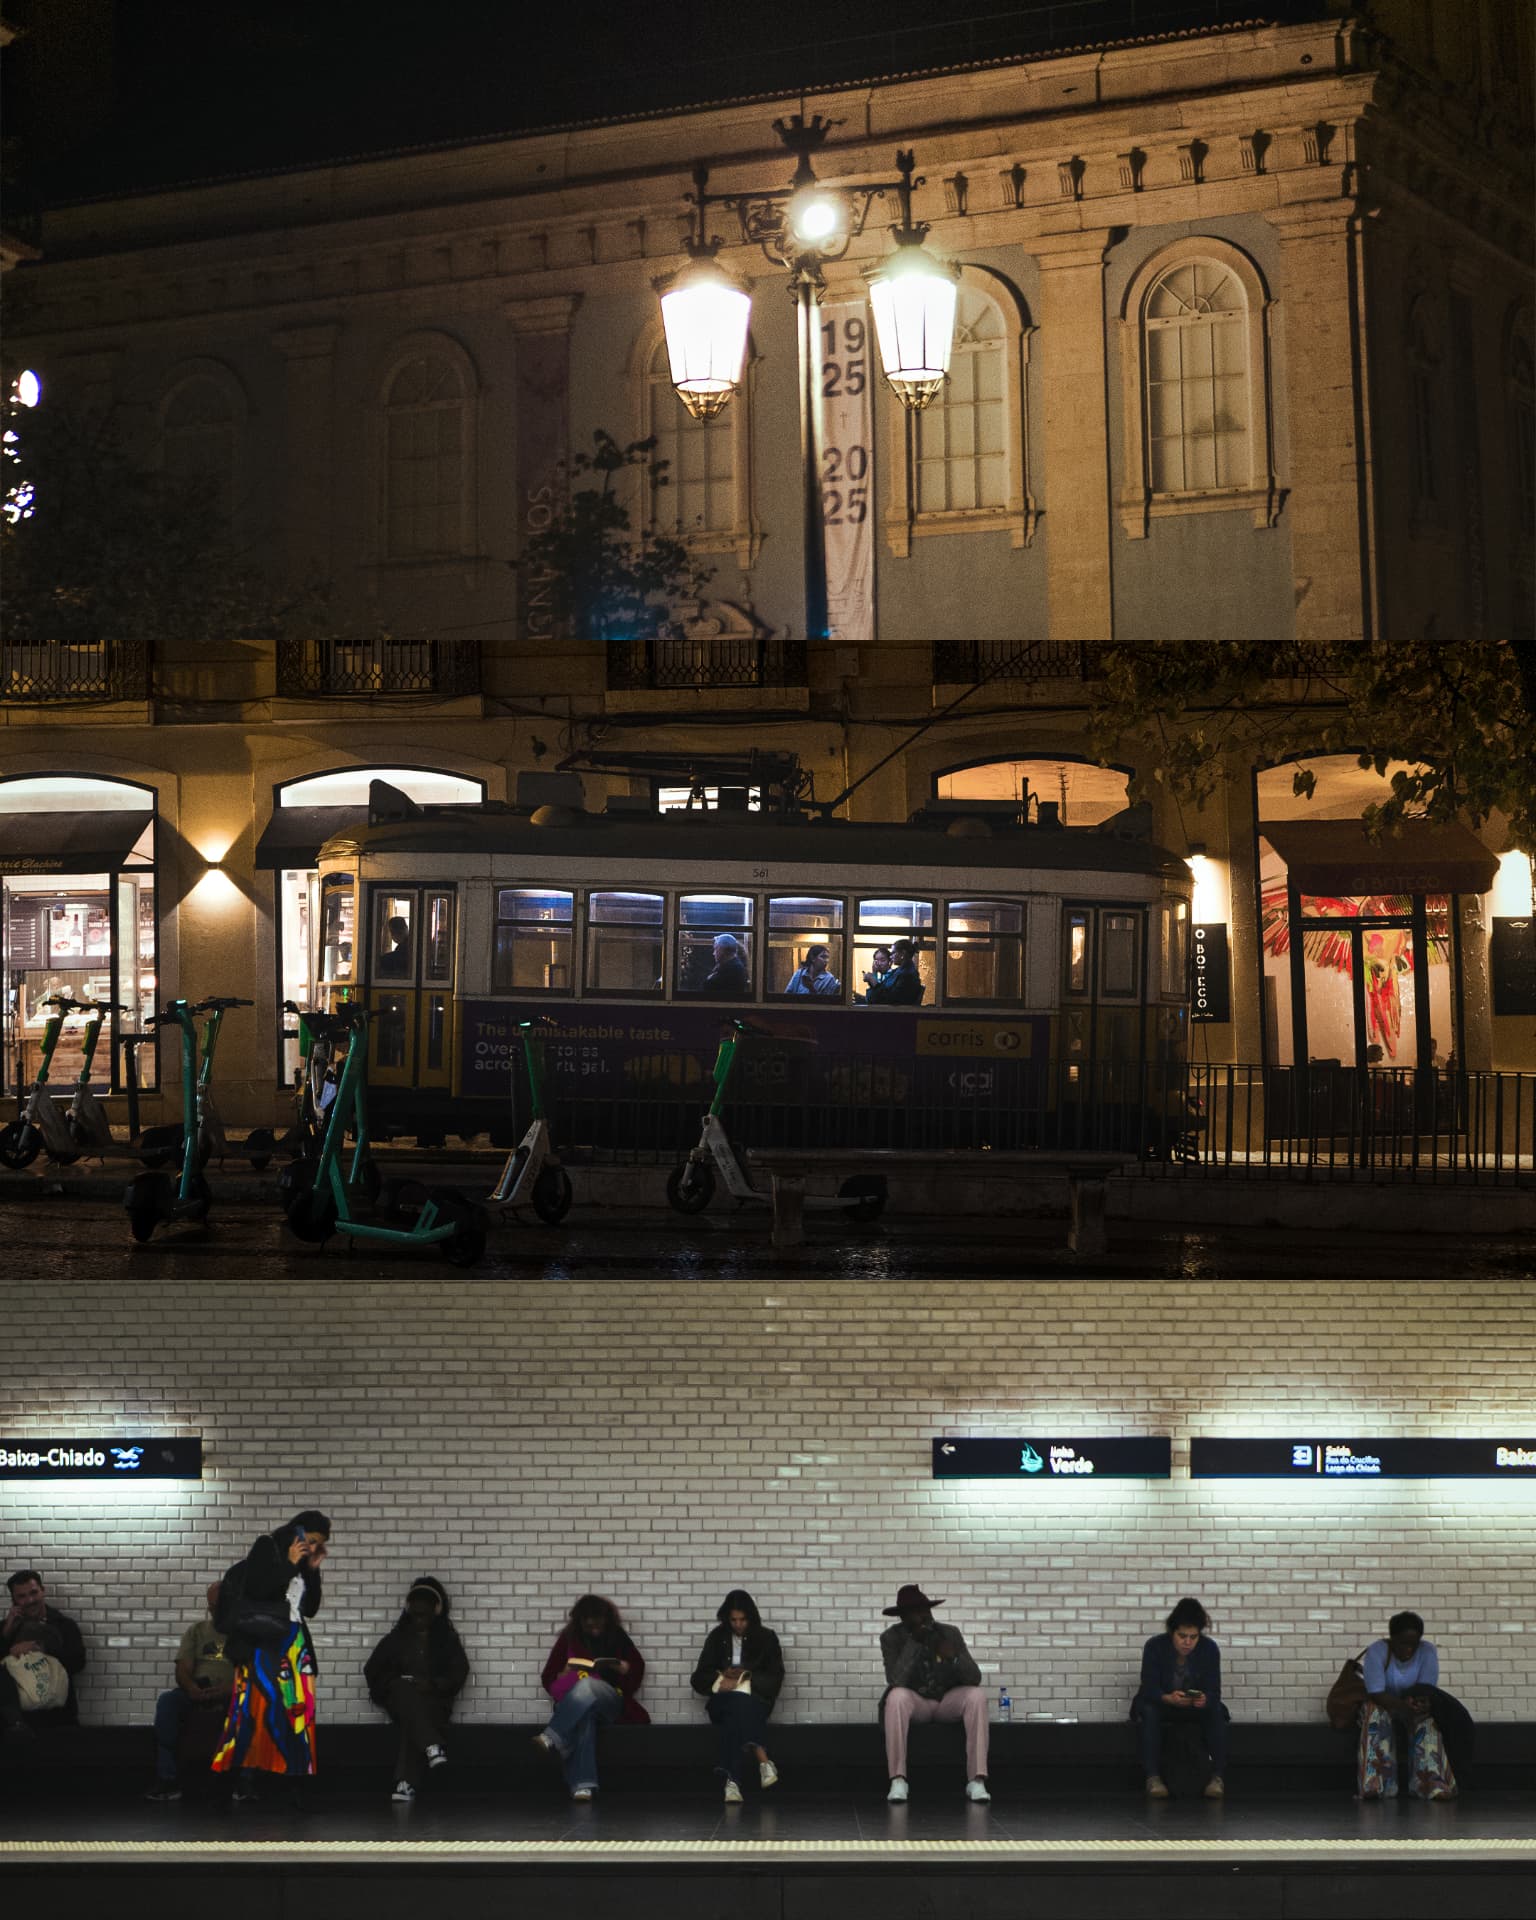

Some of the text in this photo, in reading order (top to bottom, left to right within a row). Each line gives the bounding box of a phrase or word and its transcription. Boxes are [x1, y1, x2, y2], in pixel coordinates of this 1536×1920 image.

[821, 317, 866, 355] 19
[822, 359, 866, 397] 25
[822, 445, 867, 482] 20
[823, 487, 867, 526] 25
[752, 867, 769, 878] 561
[1195, 928, 1206, 940] O
[1196, 943, 1208, 1009] BOTECO
[476, 1022, 507, 1037] The
[629, 1028, 675, 1041] taste.
[928, 1028, 984, 1046] carris
[0, 1448, 106, 1467] Baixa-Chiado
[1050, 1457, 1095, 1474] Verde
